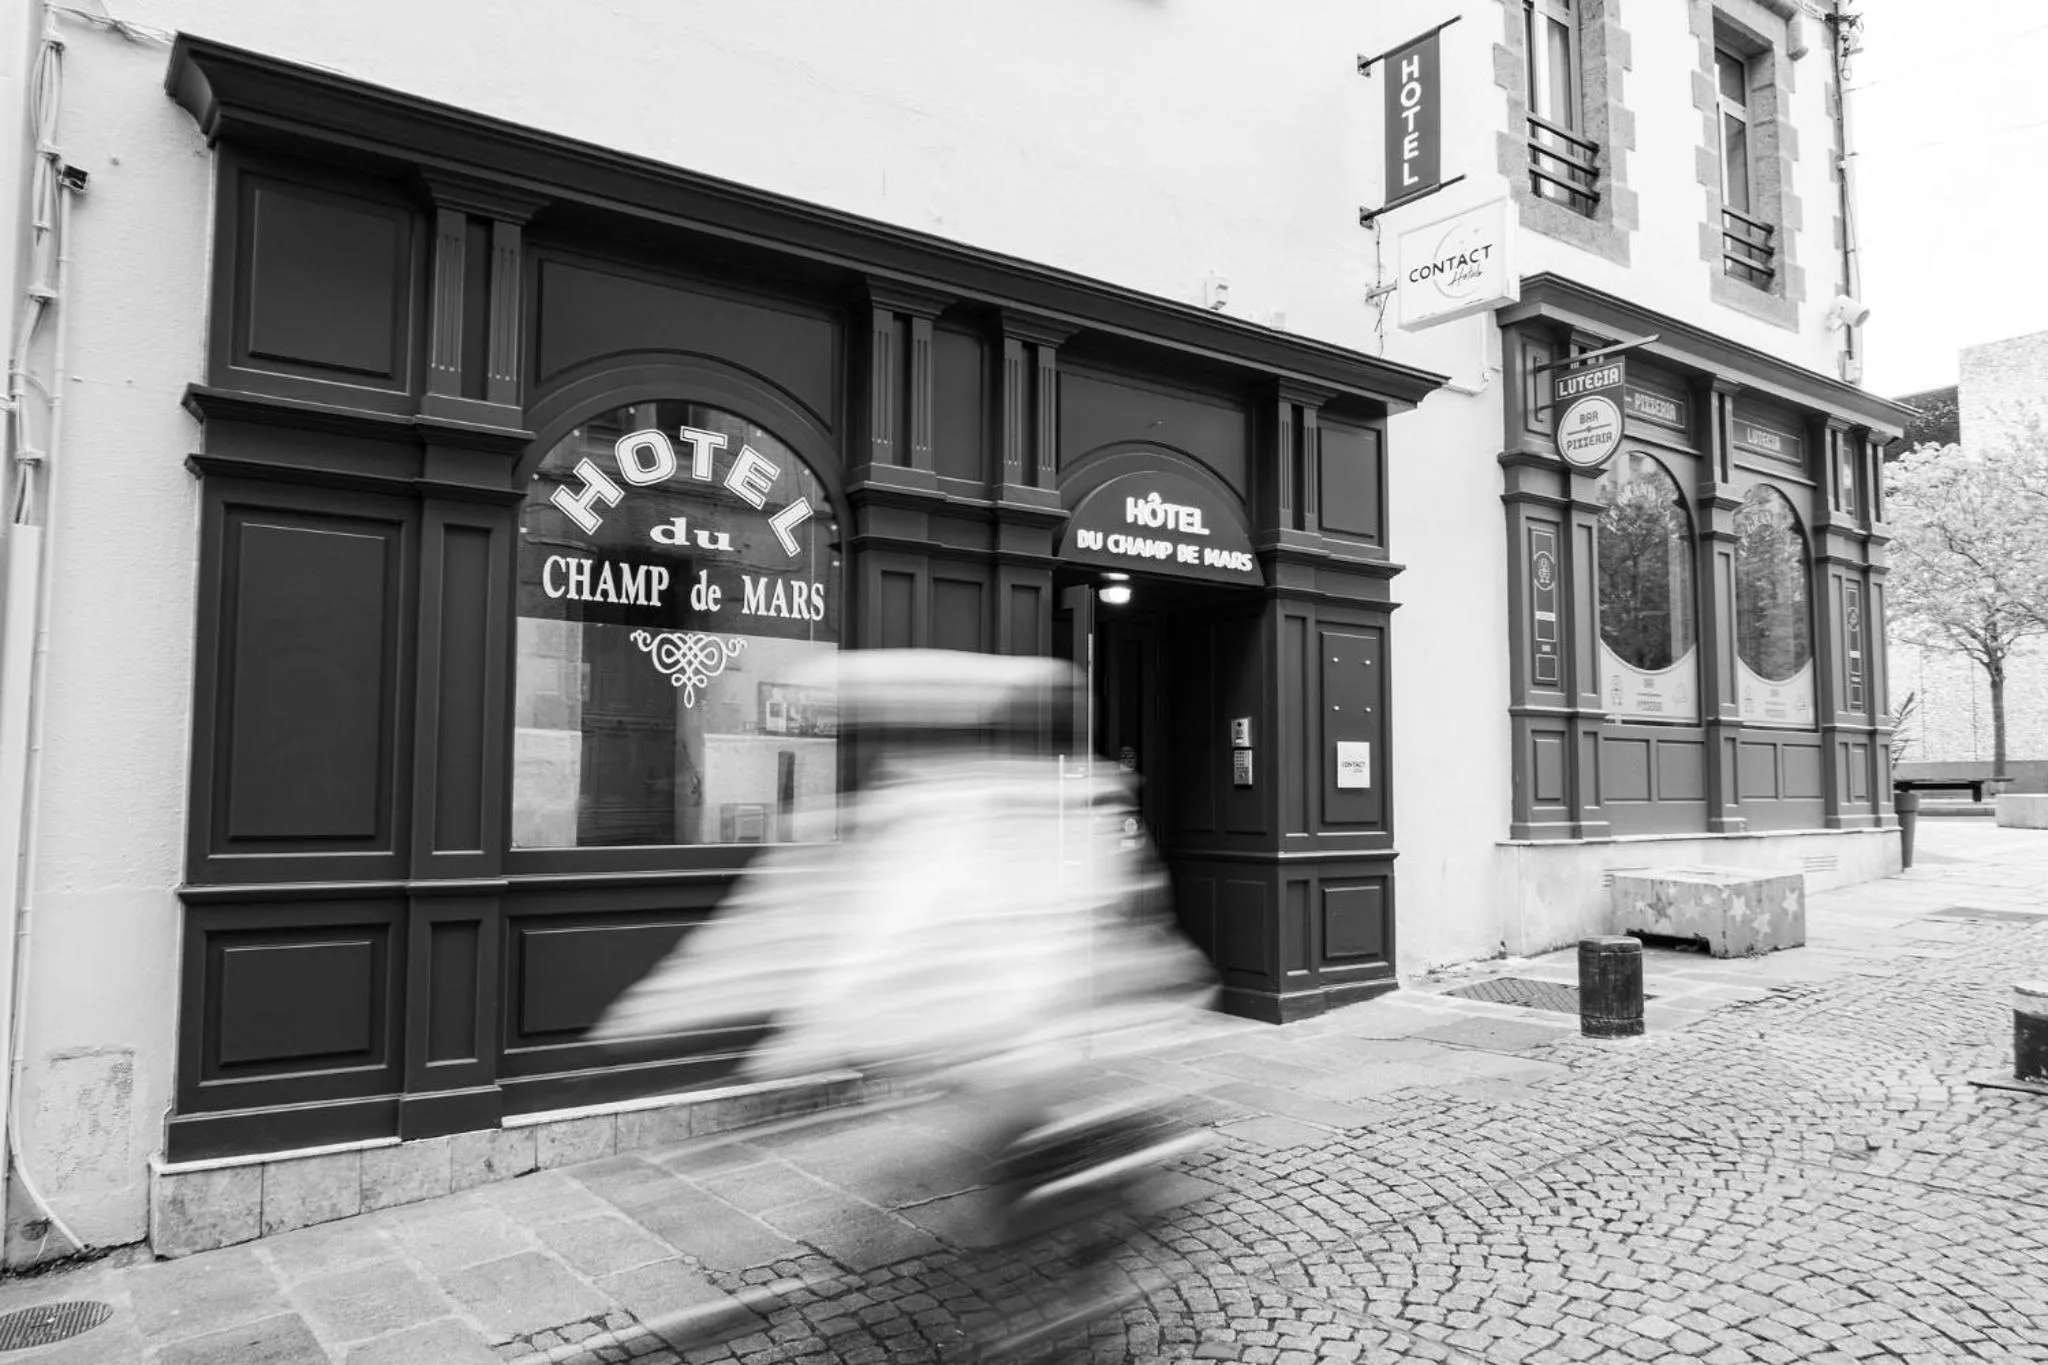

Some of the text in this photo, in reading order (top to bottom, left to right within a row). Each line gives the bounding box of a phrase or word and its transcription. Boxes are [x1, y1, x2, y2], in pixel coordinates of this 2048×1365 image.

[1401, 54, 1422, 186] HOTEL
[1409, 243, 1493, 283] CONTACT
[1558, 367, 1620, 397] LUTECIA
[1579, 410, 1599, 425] BAR
[1565, 431, 1613, 452] PIZZERIA
[550, 425, 814, 557] HOTEL
[650, 517, 734, 551] du
[1125, 492, 1210, 536] HÔTEL
[1076, 529, 1253, 572] DU CHAMP DE MARS
[542, 554, 825, 621] CHAMP de MARS
